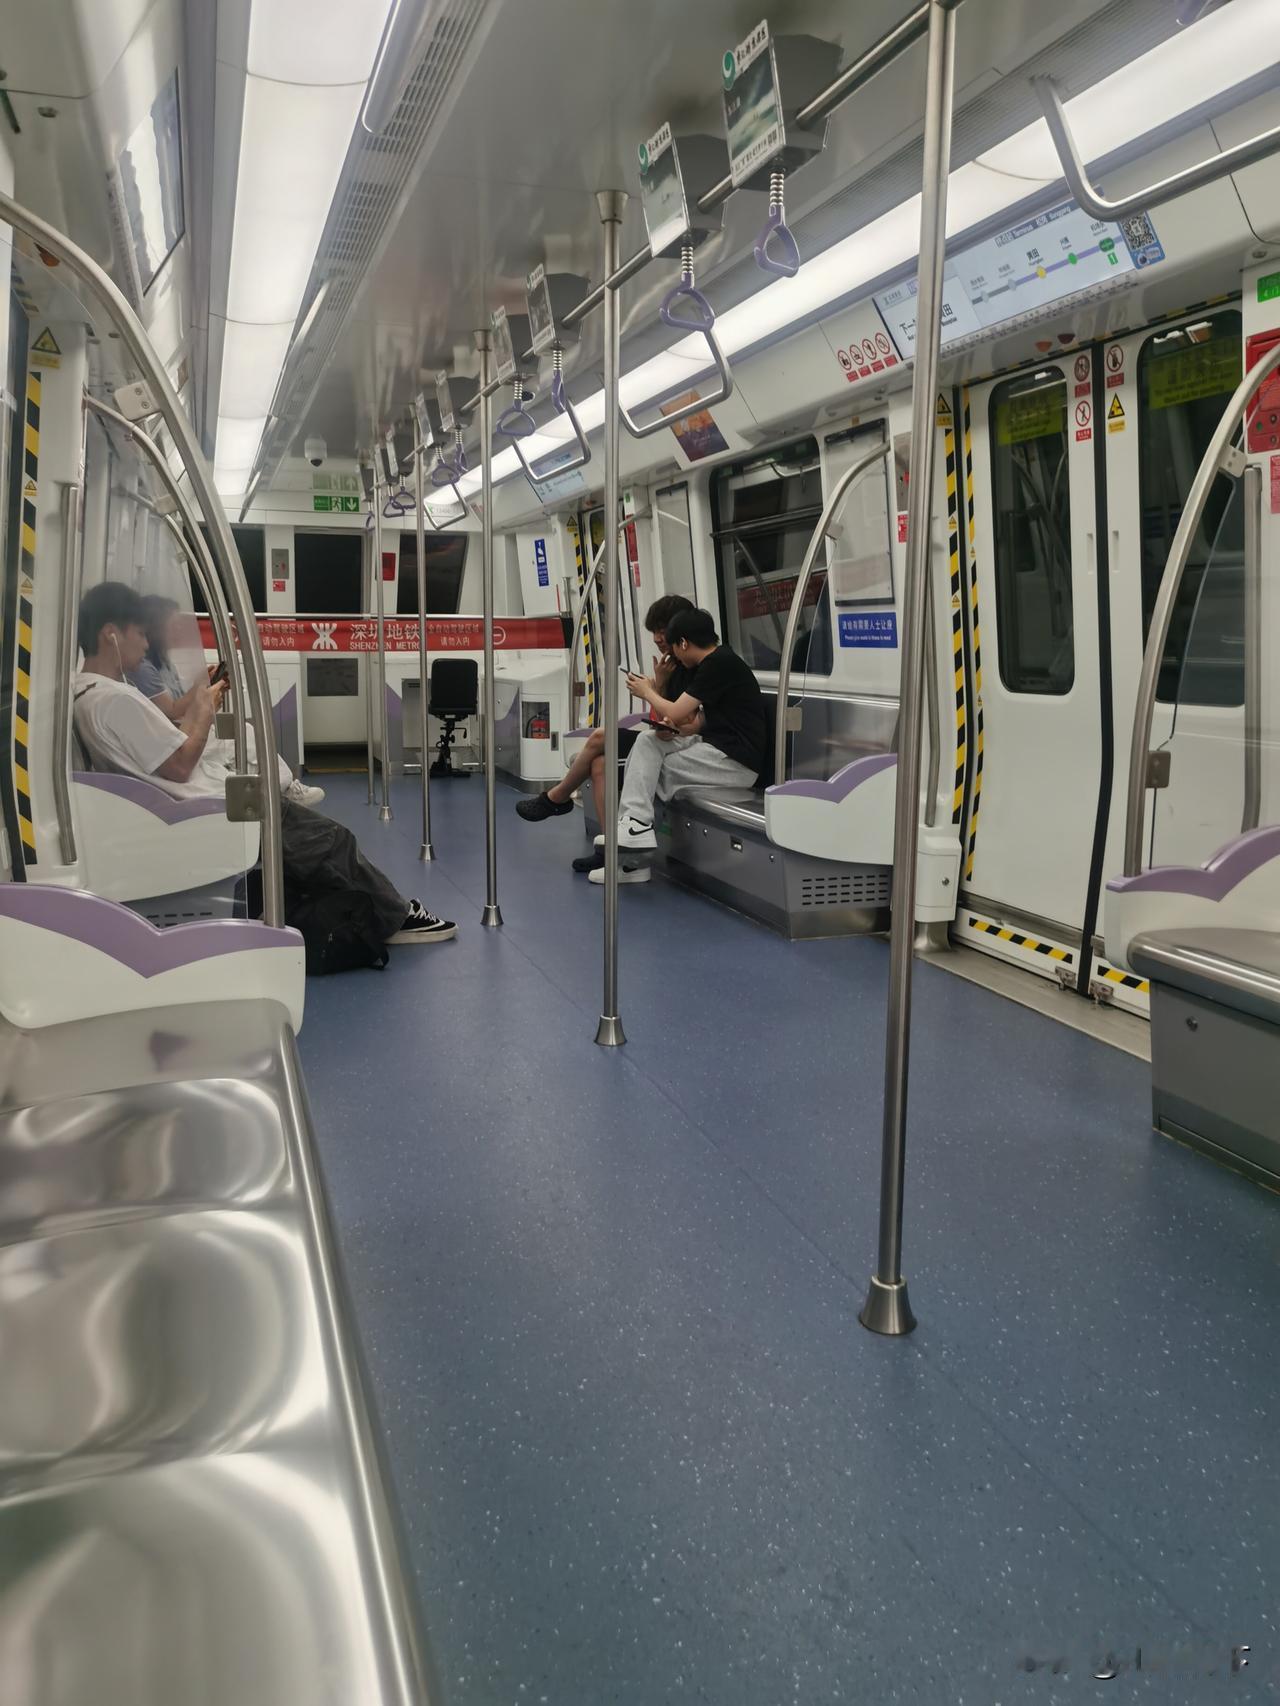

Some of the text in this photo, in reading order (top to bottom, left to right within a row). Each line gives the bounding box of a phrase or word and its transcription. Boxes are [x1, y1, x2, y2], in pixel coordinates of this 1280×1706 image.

[257, 623, 304, 634] 自动驾驶区域
[350, 623, 420, 640] 深圳地铁
[263, 636, 295, 647] 请勿入内
[350, 641, 392, 650] SHENZN
[440, 636, 470, 646] 请勿入内
